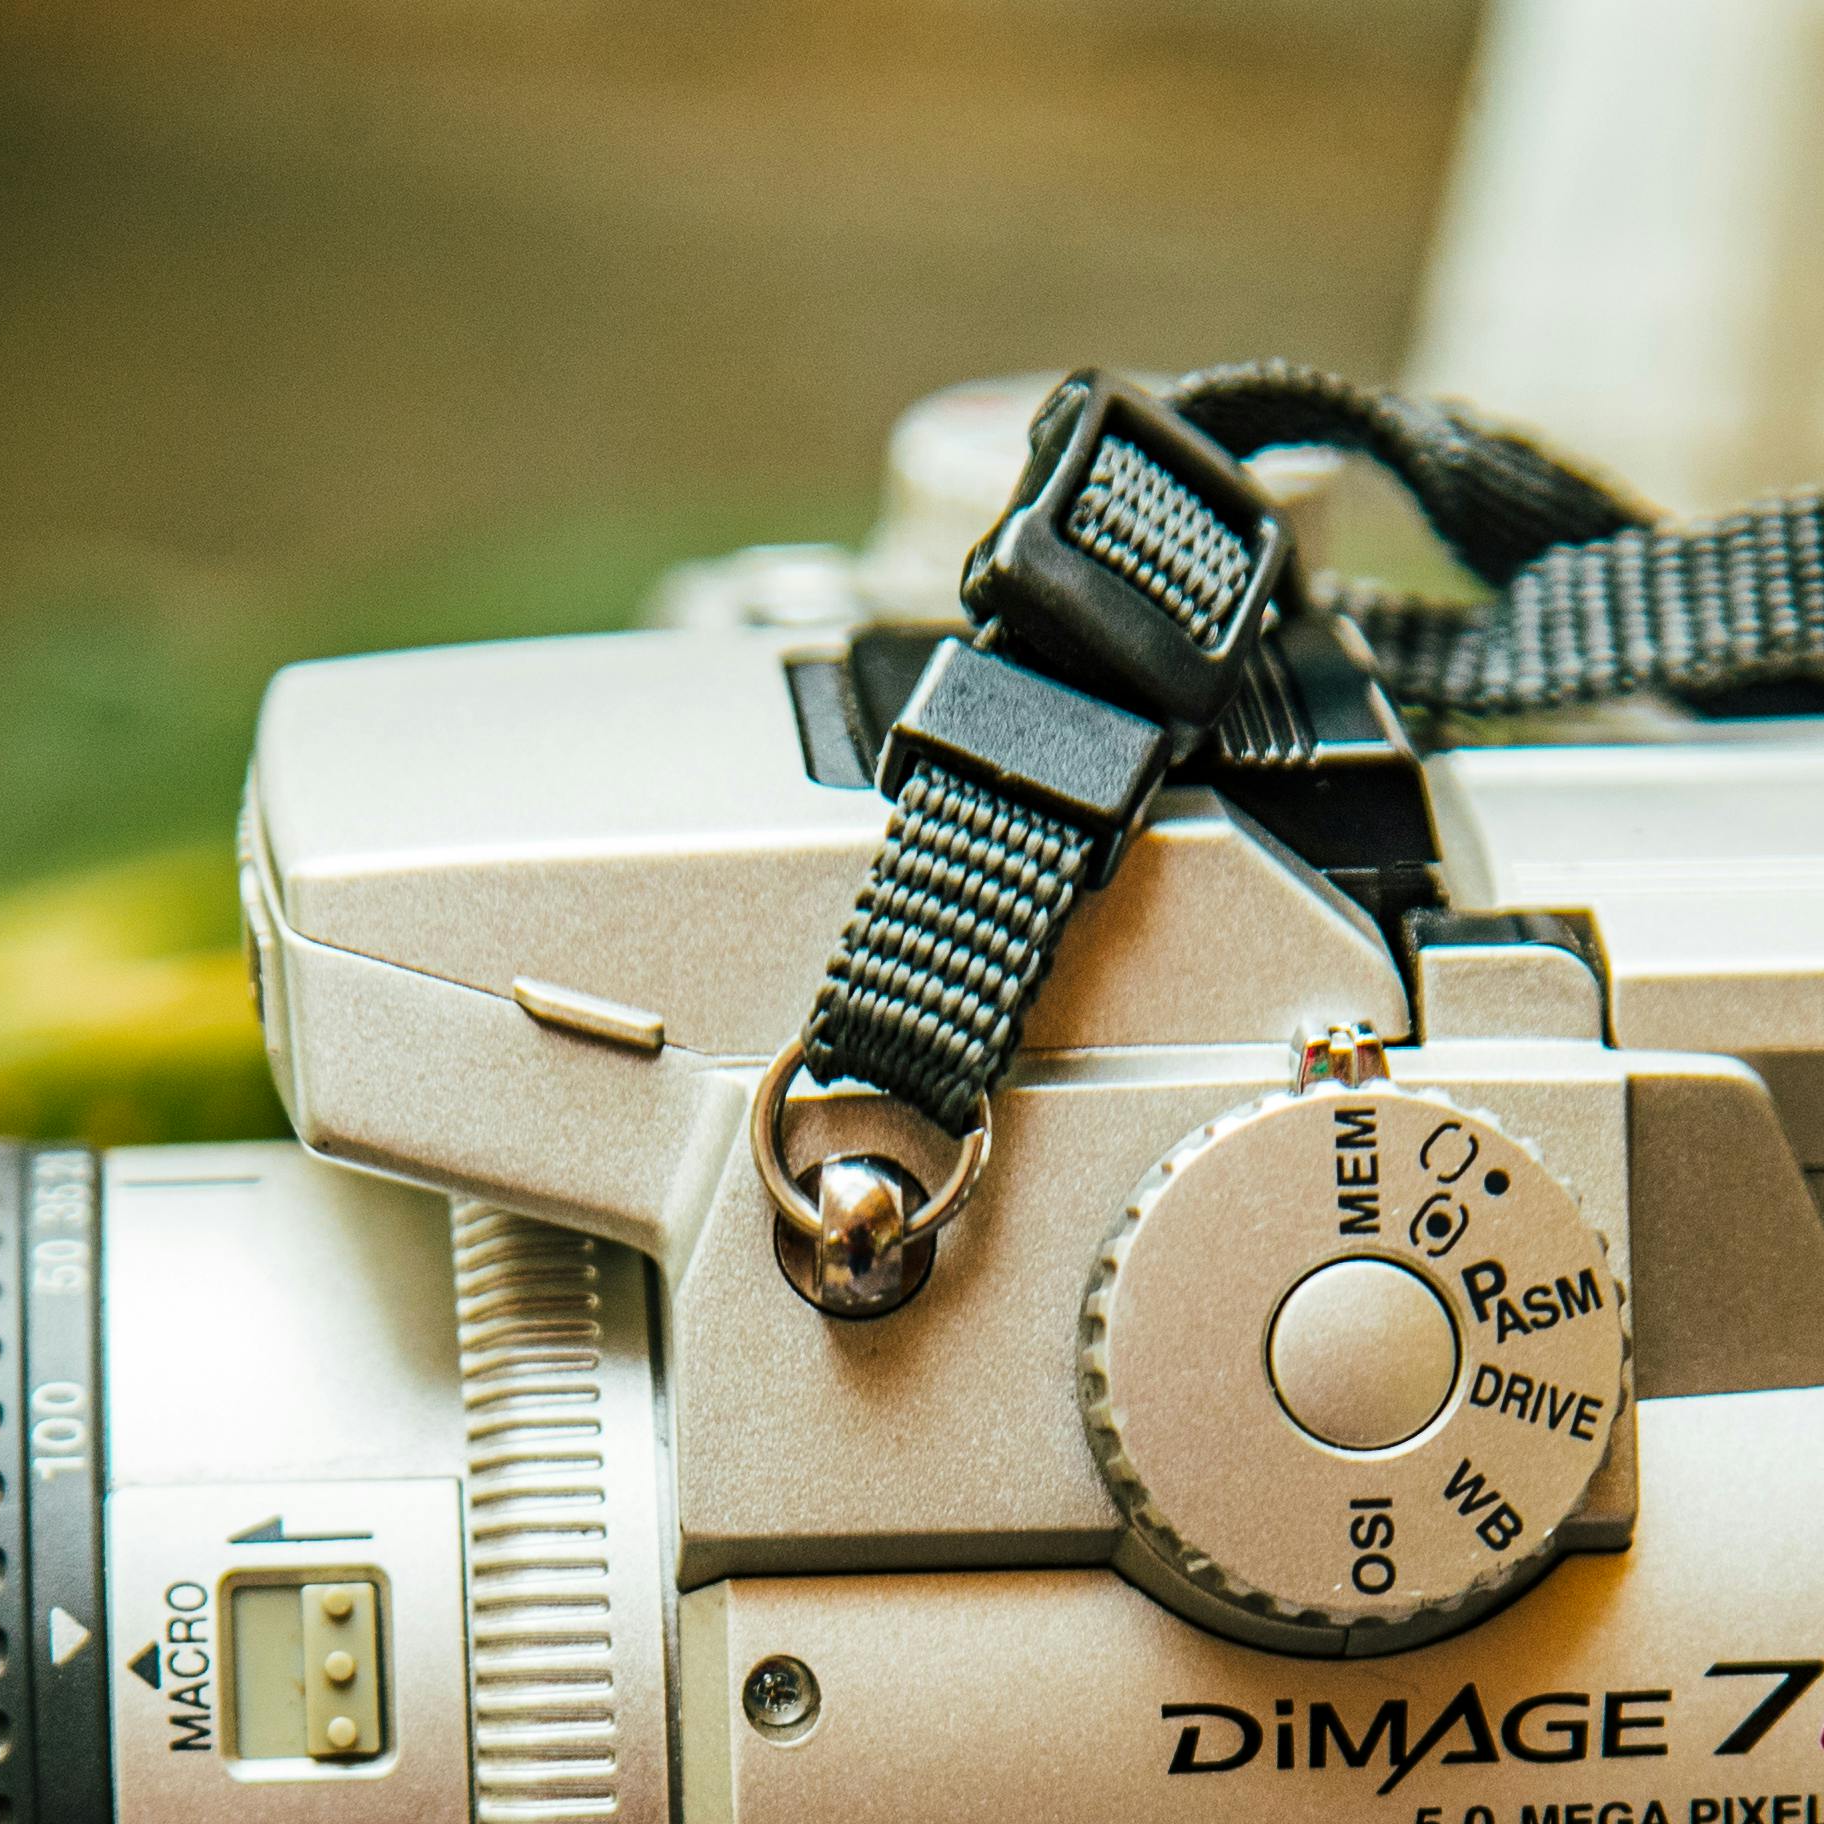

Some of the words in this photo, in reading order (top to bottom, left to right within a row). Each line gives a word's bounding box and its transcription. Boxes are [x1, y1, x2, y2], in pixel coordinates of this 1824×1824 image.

[1334, 1106, 1381, 1236] MEM
[31, 1238, 89, 1296] 50
[1462, 1258, 1603, 1344] PASM
[30, 1380, 86, 1480] 100
[1469, 1363, 1603, 1442] DRIVE
[1349, 1497, 1396, 1596] ISO
[1442, 1458, 1524, 1552] WB
[164, 1580, 212, 1751] MACRO
[1161, 1682, 1672, 1796] DiMAGE
